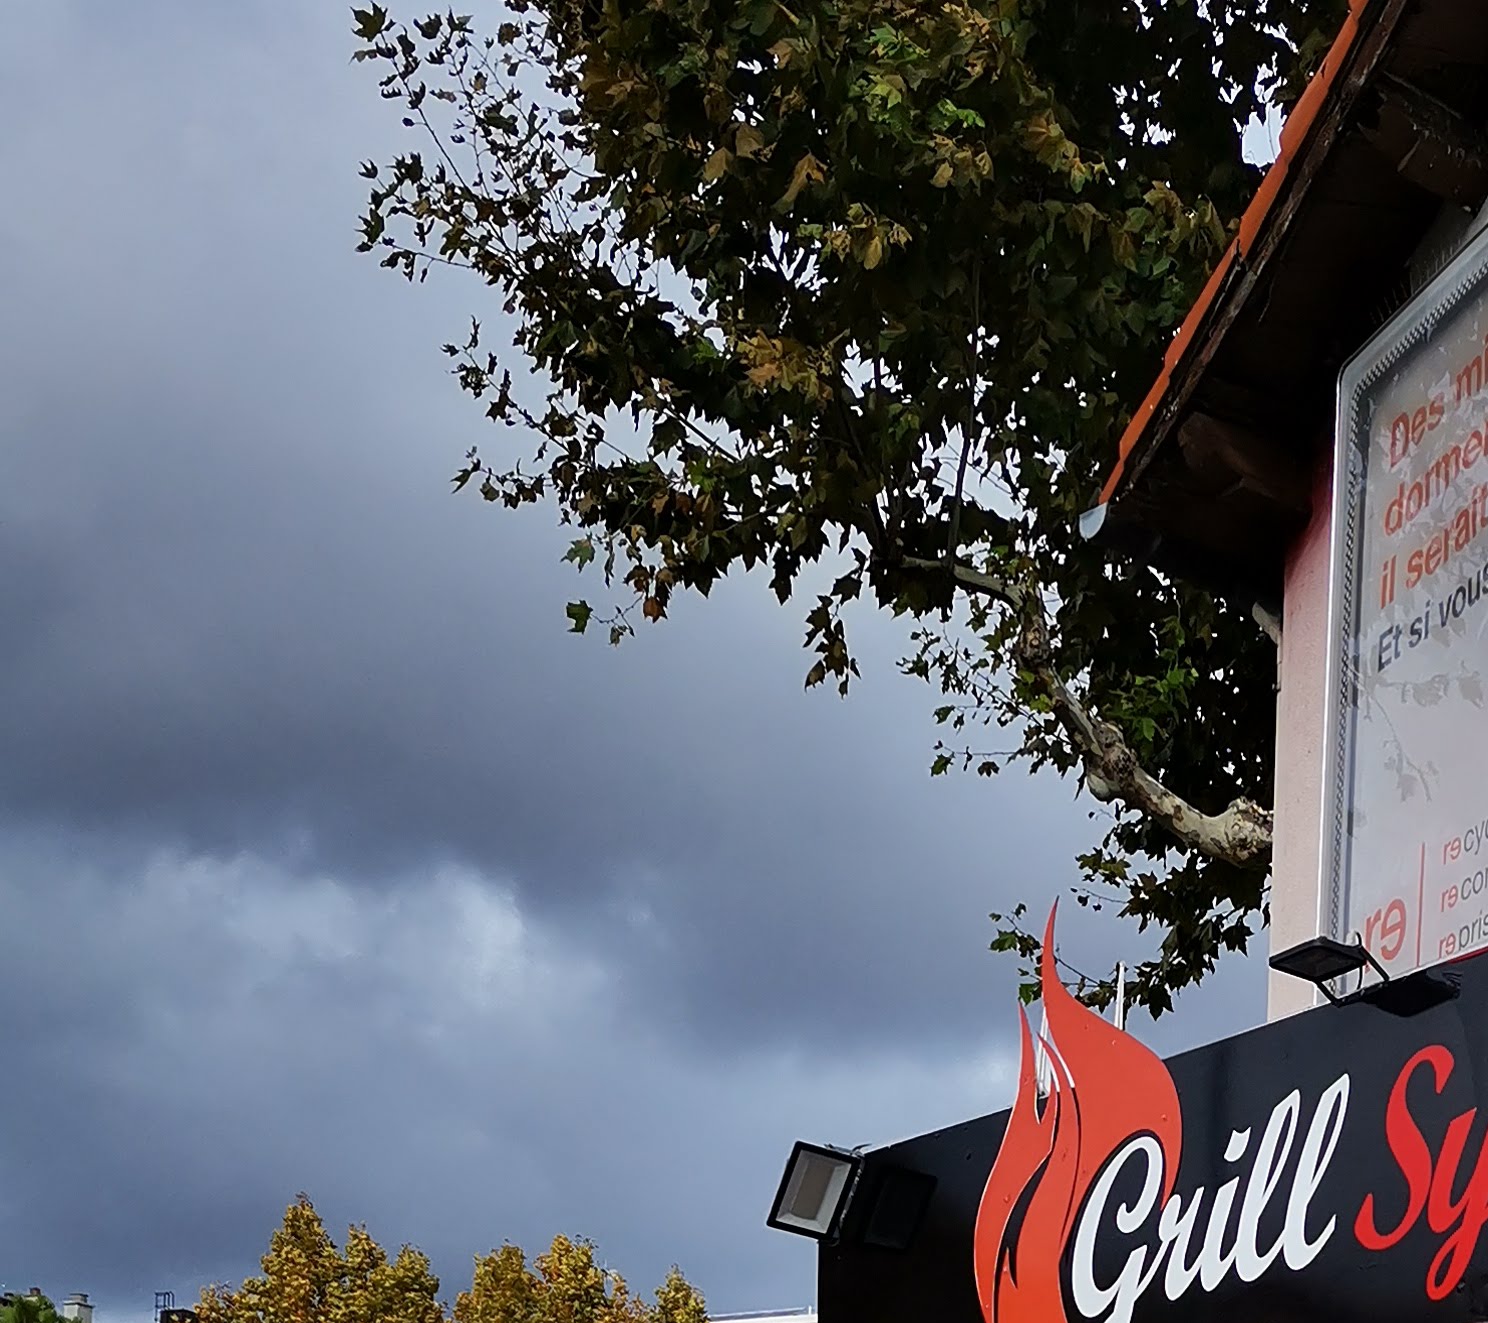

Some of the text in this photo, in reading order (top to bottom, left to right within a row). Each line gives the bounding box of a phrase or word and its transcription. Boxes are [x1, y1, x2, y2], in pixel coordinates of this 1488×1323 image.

[1389, 391, 1446, 469] Des
[1379, 553, 1398, 610] il
[1376, 624, 1403, 674] Et
[1407, 600, 1432, 648] si
